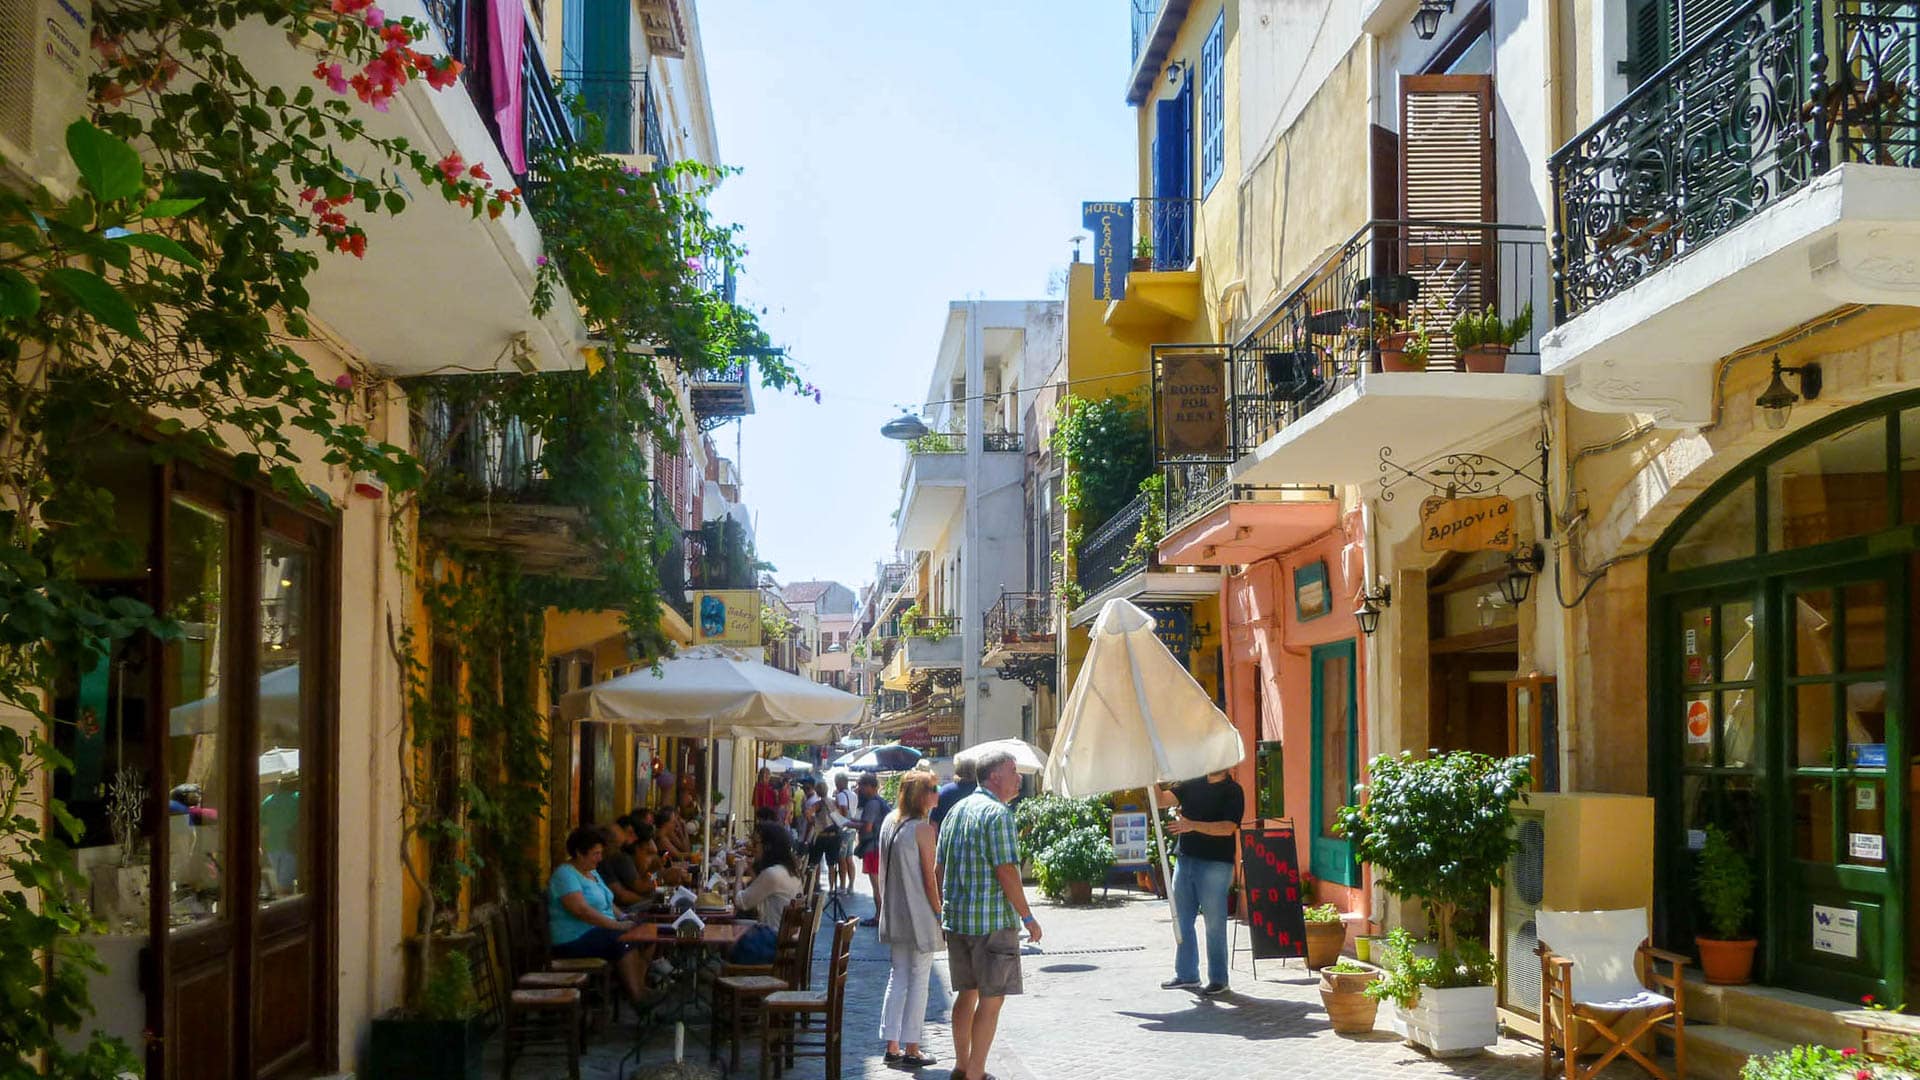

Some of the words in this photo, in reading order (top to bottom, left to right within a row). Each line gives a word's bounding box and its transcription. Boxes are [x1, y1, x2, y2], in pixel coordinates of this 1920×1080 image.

[1085, 203, 1124, 217] HOTEL
[1170, 384, 1219, 395] ROOMS
[1181, 398, 1208, 409] FOR
[1176, 411, 1216, 422] RENT
[931, 735, 958, 744] MARKET
[1245, 833, 1298, 884] ROOMS
[1250, 886, 1297, 905] FOR
